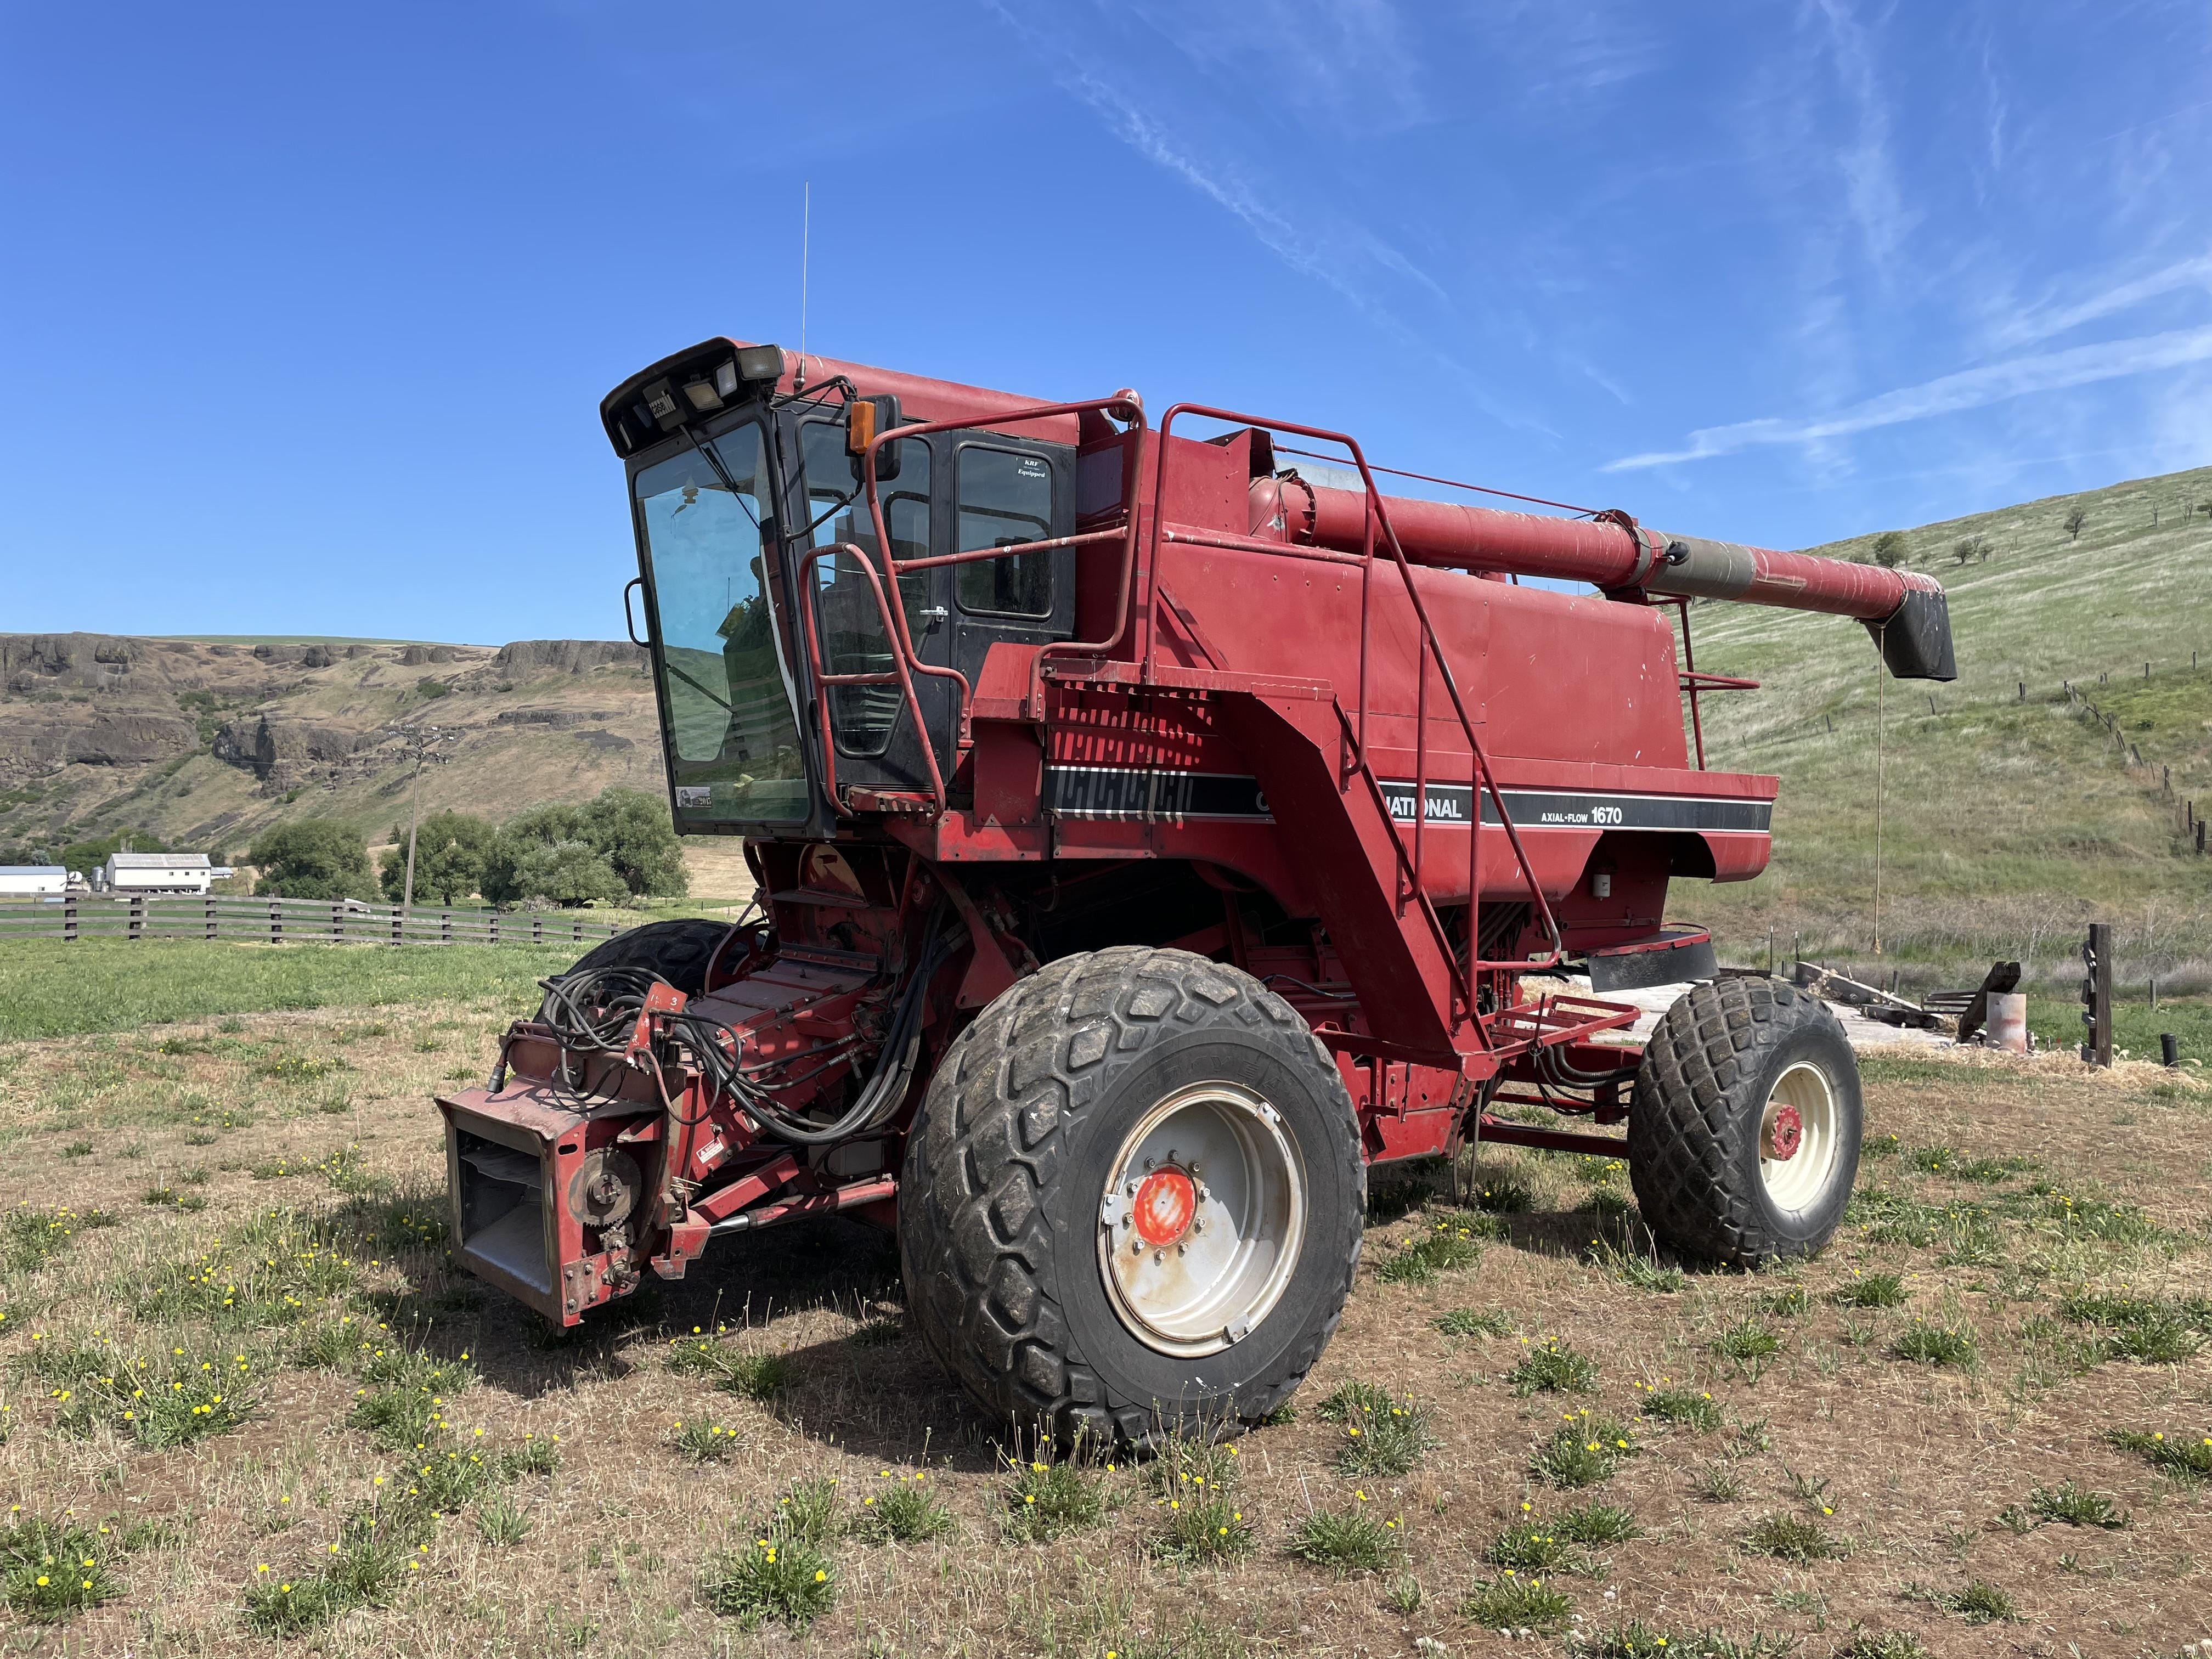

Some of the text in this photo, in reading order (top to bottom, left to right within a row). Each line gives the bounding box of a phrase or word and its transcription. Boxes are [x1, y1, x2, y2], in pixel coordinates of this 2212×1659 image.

[1018, 469, 1045, 478] Equipped
[1541, 806, 1622, 823] AXIAL-FLOW 1670
